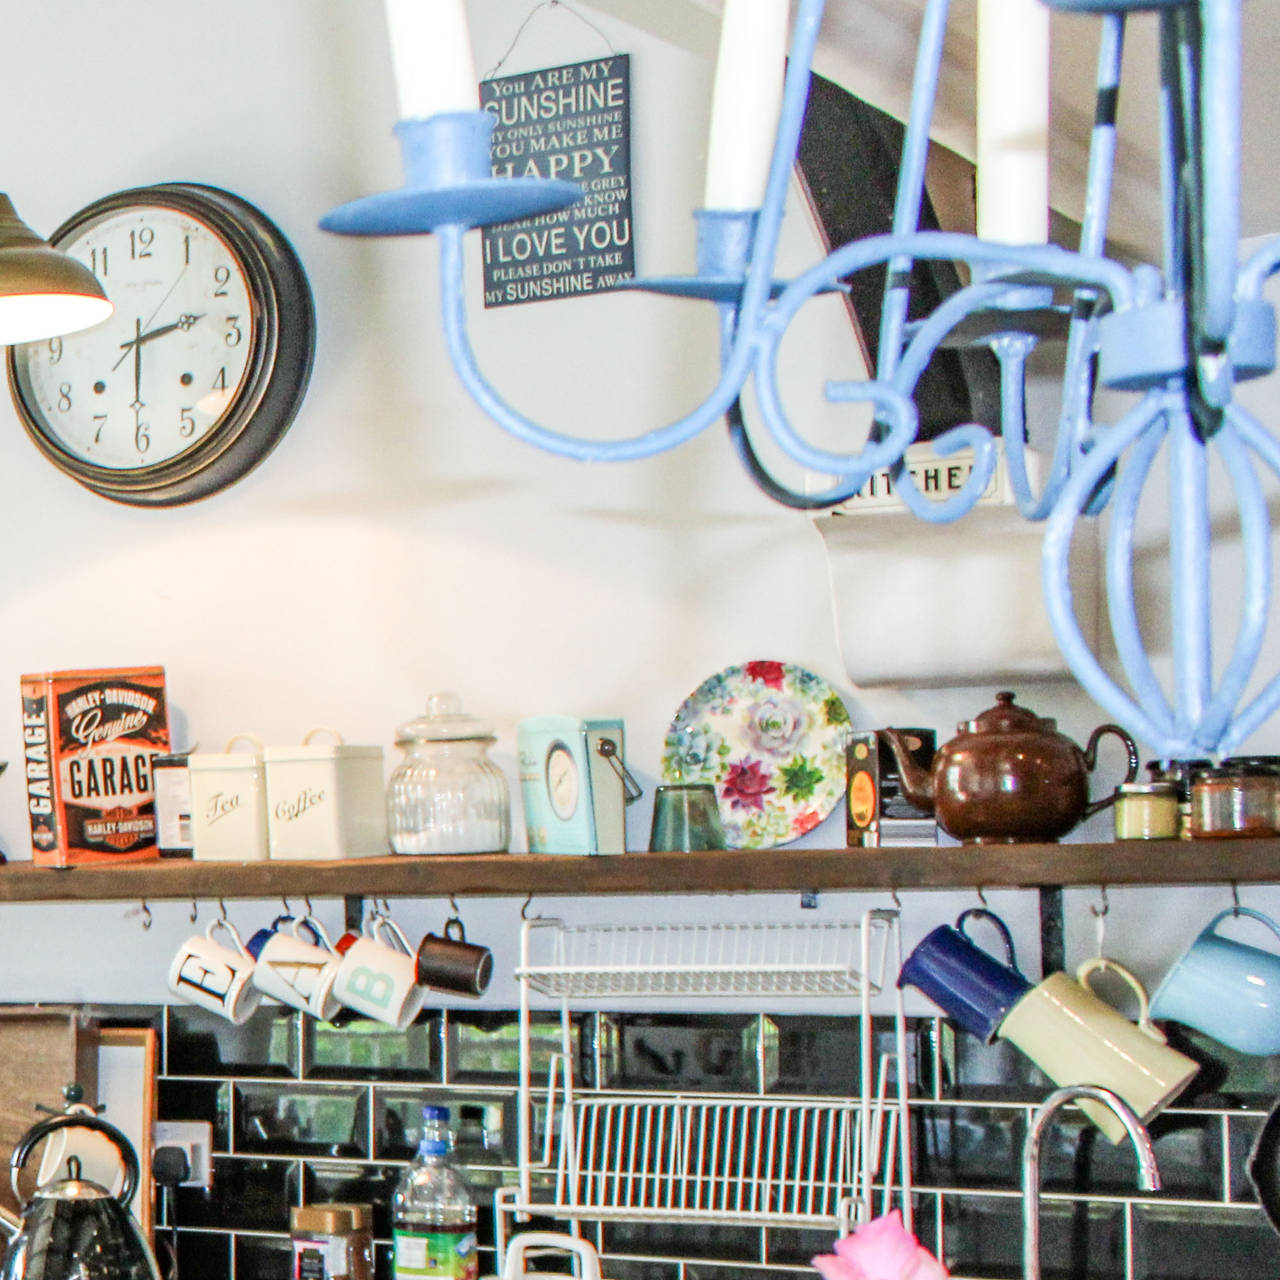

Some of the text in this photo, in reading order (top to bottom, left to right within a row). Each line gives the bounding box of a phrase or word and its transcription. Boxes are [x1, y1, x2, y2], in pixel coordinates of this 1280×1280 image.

[531, 68, 575, 91] ARE
[579, 60, 613, 81] MY
[484, 78, 625, 129] SUNSHINE
[507, 123, 546, 140] ONLY
[547, 111, 624, 133] SUNSHINE
[529, 130, 589, 153] MAKE
[592, 124, 624, 143] ME
[491, 145, 620, 180] HAPPY
[584, 188, 630, 206] KNOW
[591, 175, 628, 192] GREY
[535, 210, 572, 227] HOW
[573, 202, 620, 220] MUCH
[129, 227, 155, 260] 12
[183, 235, 191, 266] 1
[485, 218, 630, 265] I LOVE YOU
[91, 247, 108, 277] 11
[492, 262, 541, 282] PLEASE
[587, 251, 624, 269] TAKE
[213, 266, 231, 297] 2
[485, 289, 504, 304] MY
[505, 272, 593, 301] SUNSHINE
[225, 315, 242, 348] 3
[48, 337, 63, 365] 9
[211, 367, 230, 393] 4
[58, 383, 73, 413] 8
[93, 414, 109, 444] 7
[134, 422, 151, 453] 6
[179, 407, 196, 438] 5
[855, 465, 974, 498] ITHE
[71, 708, 149, 753] Genuine
[23, 712, 53, 815] GARAGE
[206, 792, 239, 819] Tea
[275, 787, 325, 821] Coffee
[177, 953, 238, 1007] E
[266, 960, 329, 1004] A
[346, 966, 395, 1008] B
